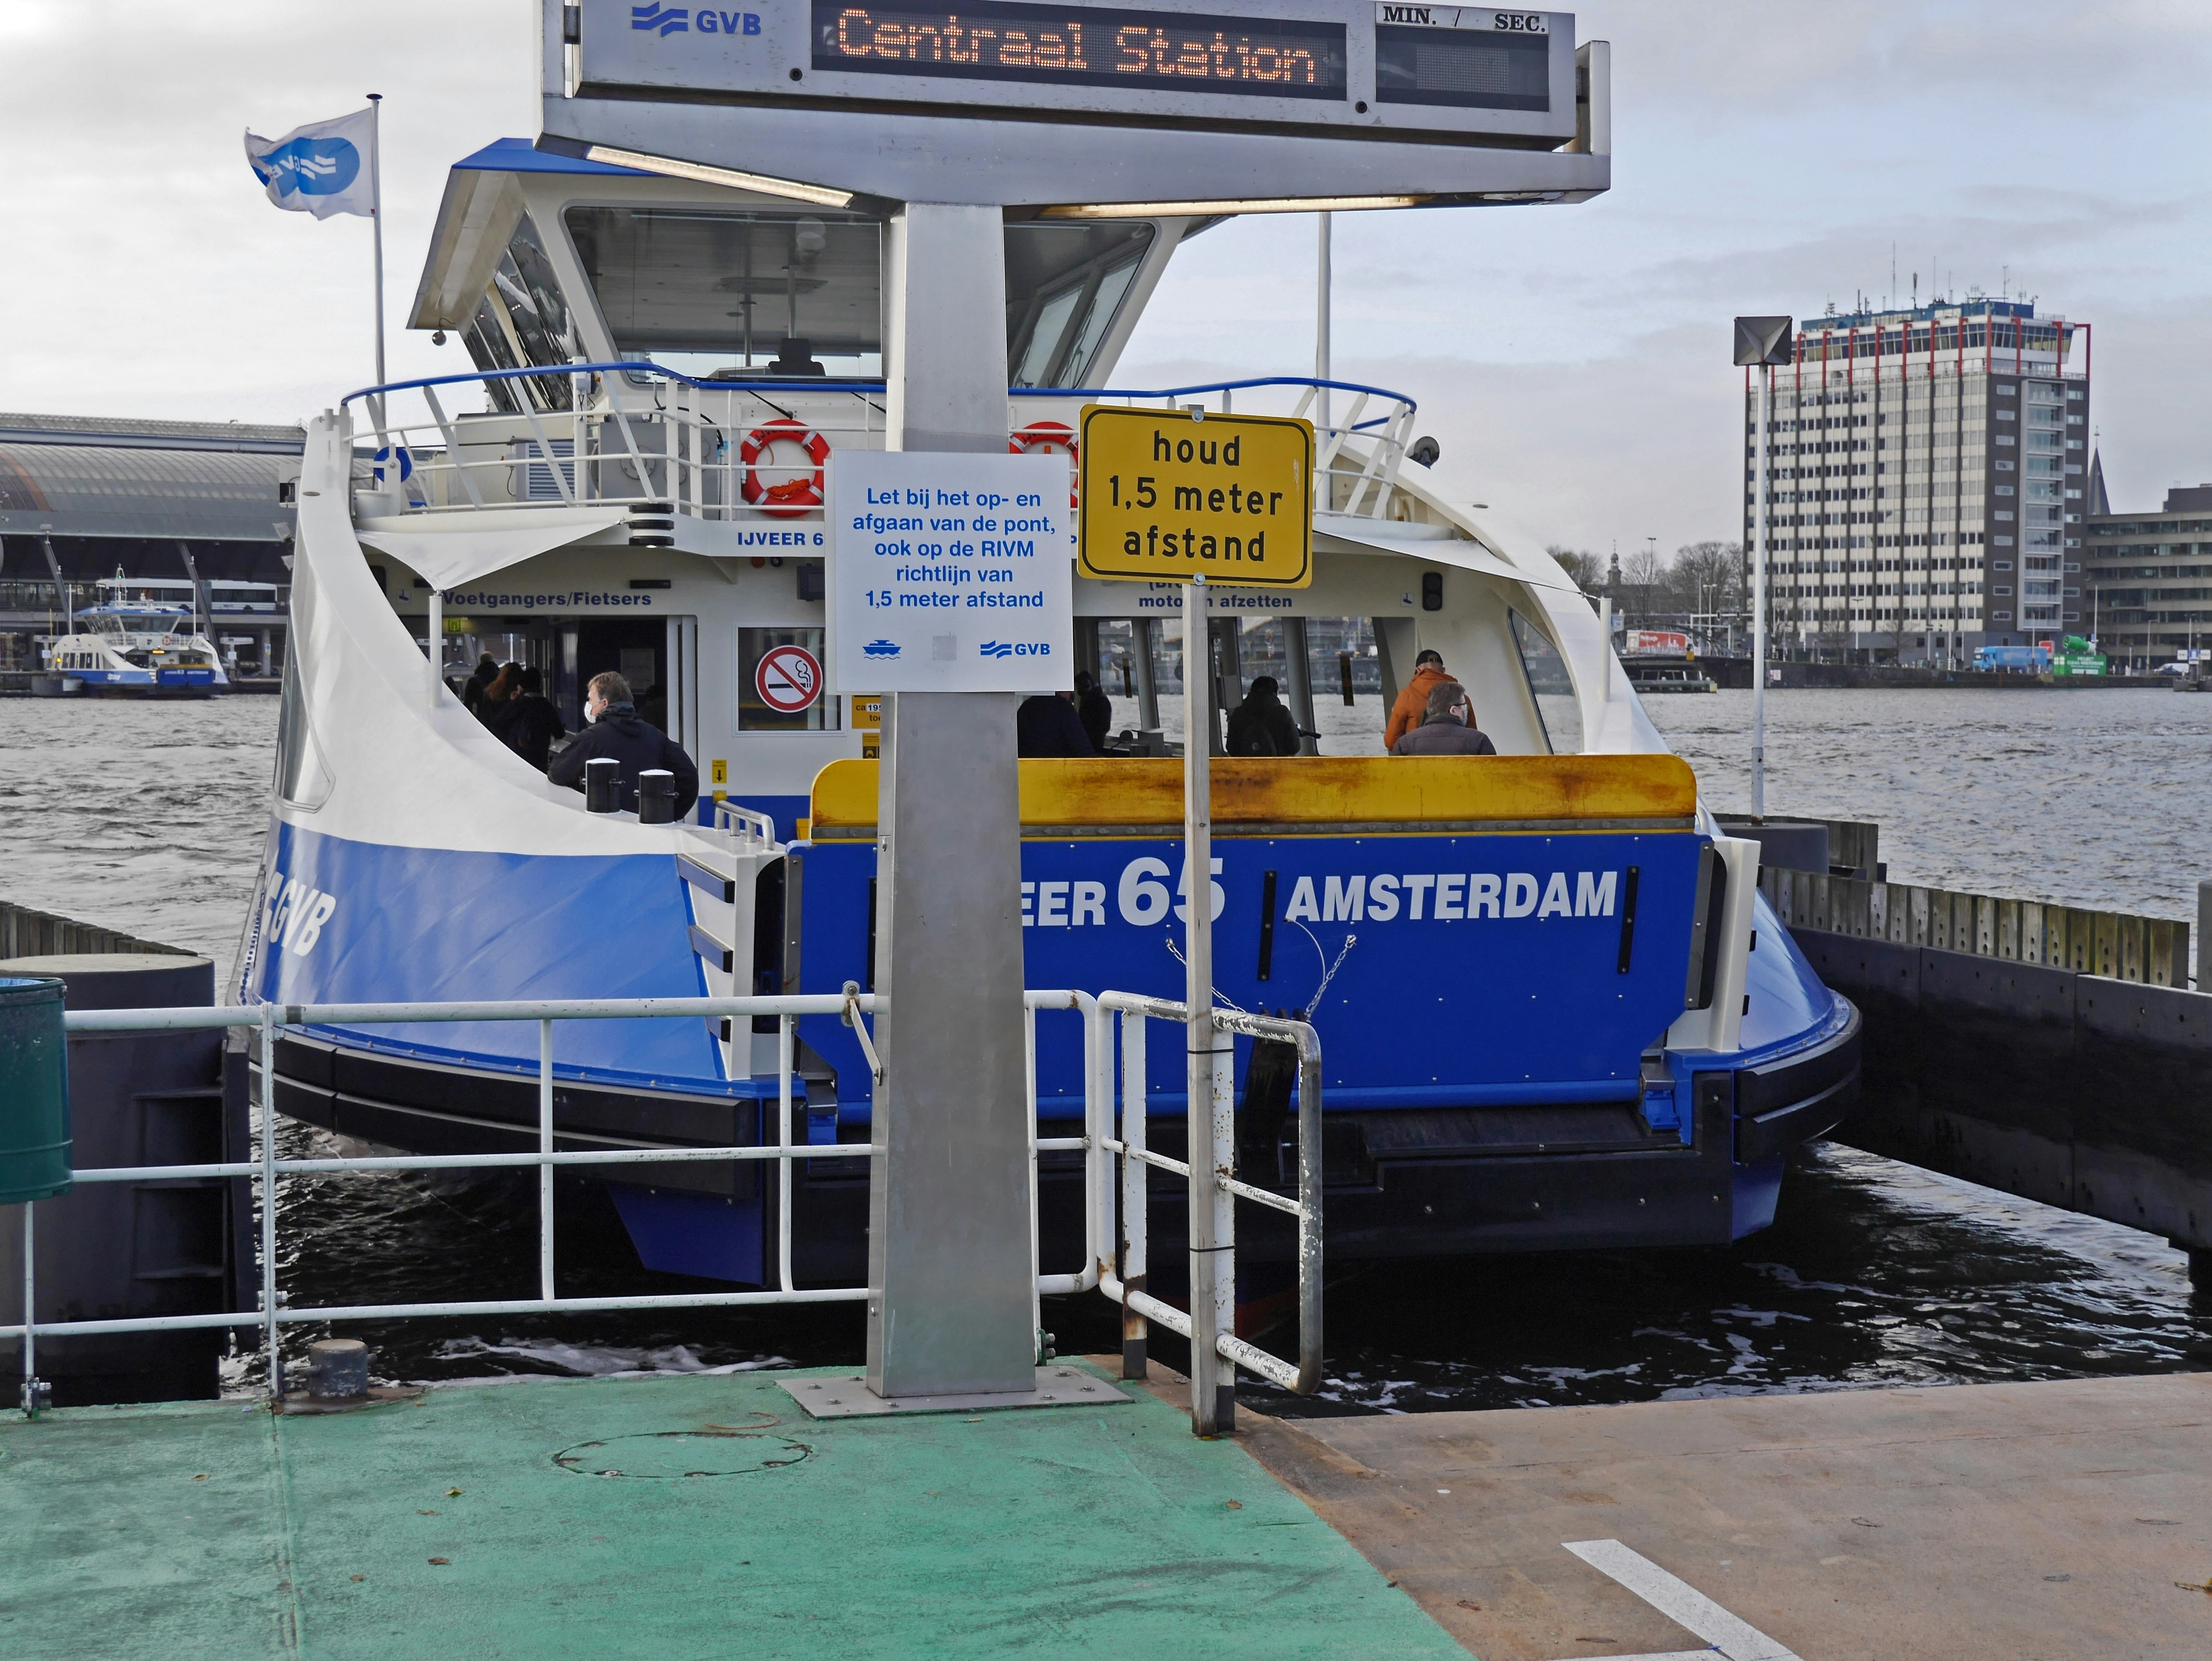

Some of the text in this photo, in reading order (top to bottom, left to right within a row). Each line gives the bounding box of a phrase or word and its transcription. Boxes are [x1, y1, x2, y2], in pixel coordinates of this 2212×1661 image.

[696, 10, 761, 36] GVB
[1383, 6, 1436, 26] MIN.
[1494, 13, 1546, 33] SEC.
[838, 8, 1314, 83] Centraal Station
[1153, 429, 1240, 466] houd
[867, 488, 1041, 510] Let bij het op- en
[1109, 475, 1283, 515] 1,5 meter
[853, 513, 1055, 536] afgaan van de pont,
[737, 532, 806, 546] IJVEER
[874, 539, 1034, 560] ook op de RIVM
[1124, 525, 1264, 562] afstand
[896, 565, 1014, 586] richtlijn van
[442, 592, 652, 608] Voetgangers/Fietsers
[866, 590, 1043, 608] 1,5 meter afstand
[1219, 594, 1292, 608] afzetten
[1014, 643, 1051, 656] GVB
[1285, 871, 1618, 922] AMSTERDAM
[270, 878, 336, 957] GVB
